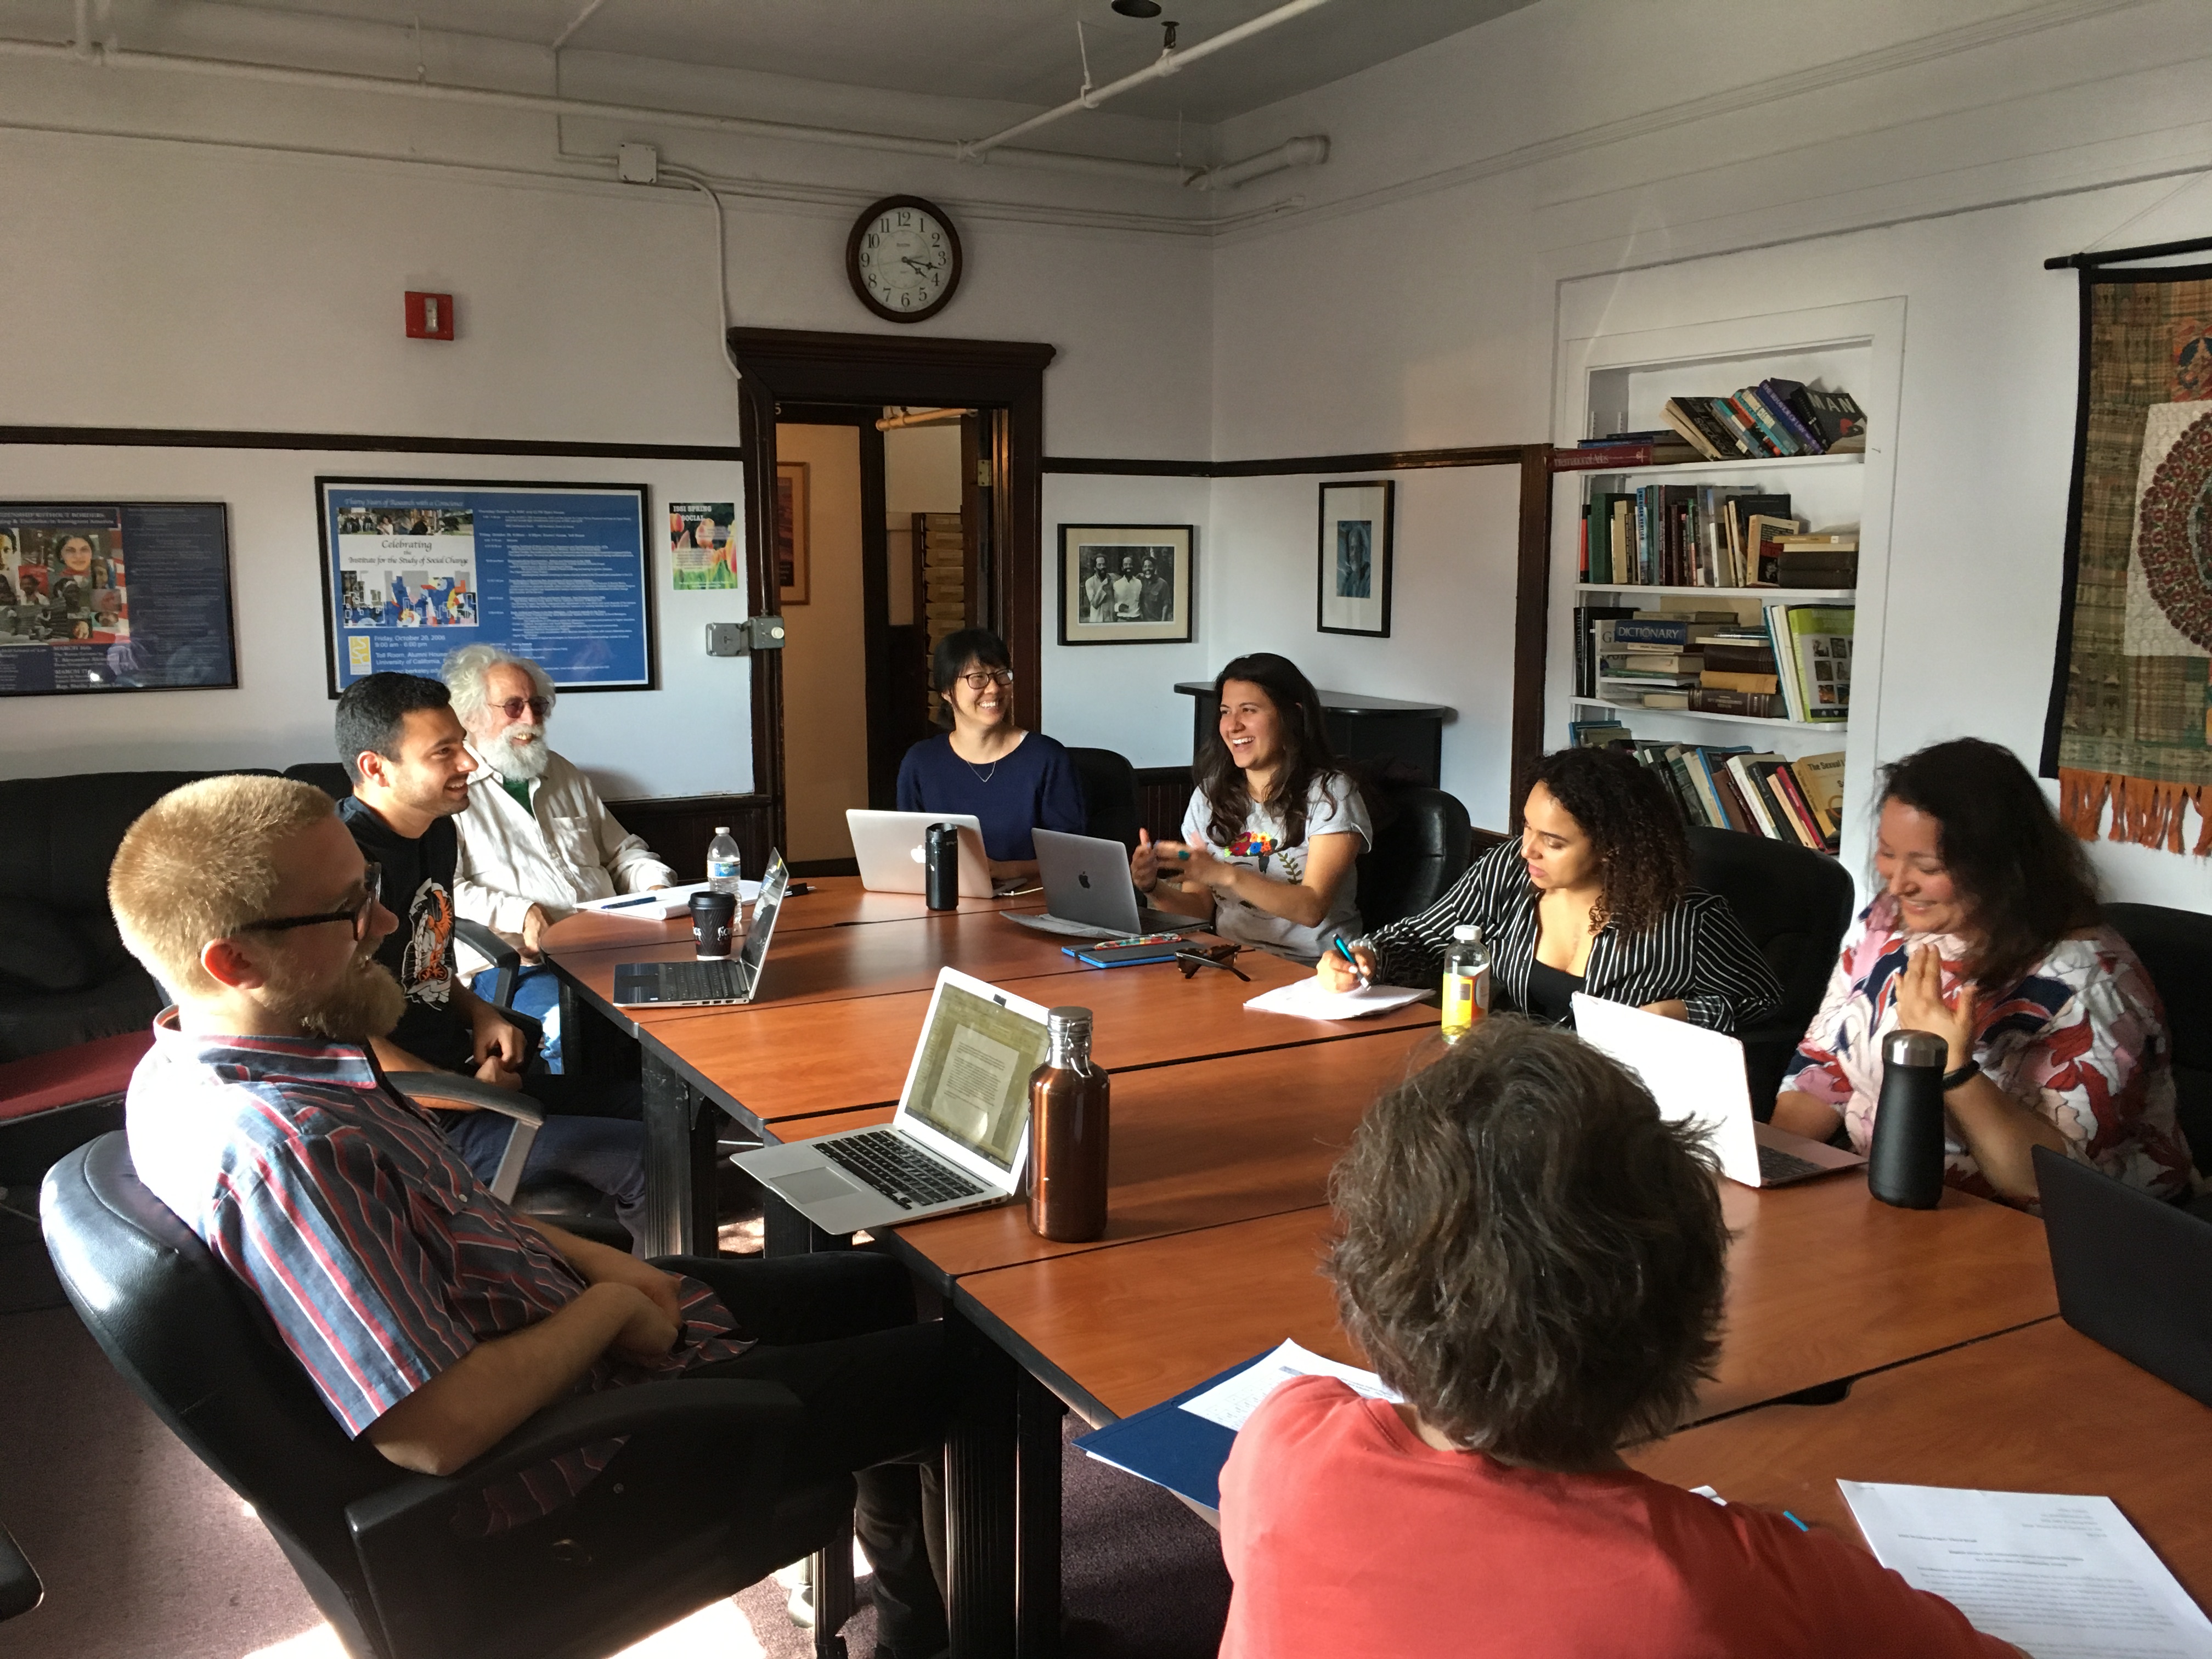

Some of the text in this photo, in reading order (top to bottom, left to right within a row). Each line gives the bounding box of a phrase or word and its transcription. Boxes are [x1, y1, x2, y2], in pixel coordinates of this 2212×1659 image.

[881, 218, 890, 233] 11
[896, 212, 911, 227] 12
[919, 218, 926, 233] 1
[868, 234, 880, 249] 10
[932, 233, 940, 247] 2
[861, 253, 870, 268] 9
[938, 251, 946, 266] 3
[868, 274, 877, 288] 8
[931, 273, 940, 286] 4
[883, 287, 891, 302] 7
[901, 292, 910, 307] 6
[919, 287, 927, 301] 5
[1763, 383, 1772, 393] THE
[1807, 392, 1855, 413] MAN
[382, 539, 432, 552] Celebrating
[377, 557, 387, 566] for
[399, 557, 417, 566] Study
[419, 557, 426, 566] of
[445, 558, 469, 566] Change
[1618, 627, 1679, 639] DICTIONARY
[1808, 763, 1820, 771] The
[1821, 761, 1841, 770] Sexual
